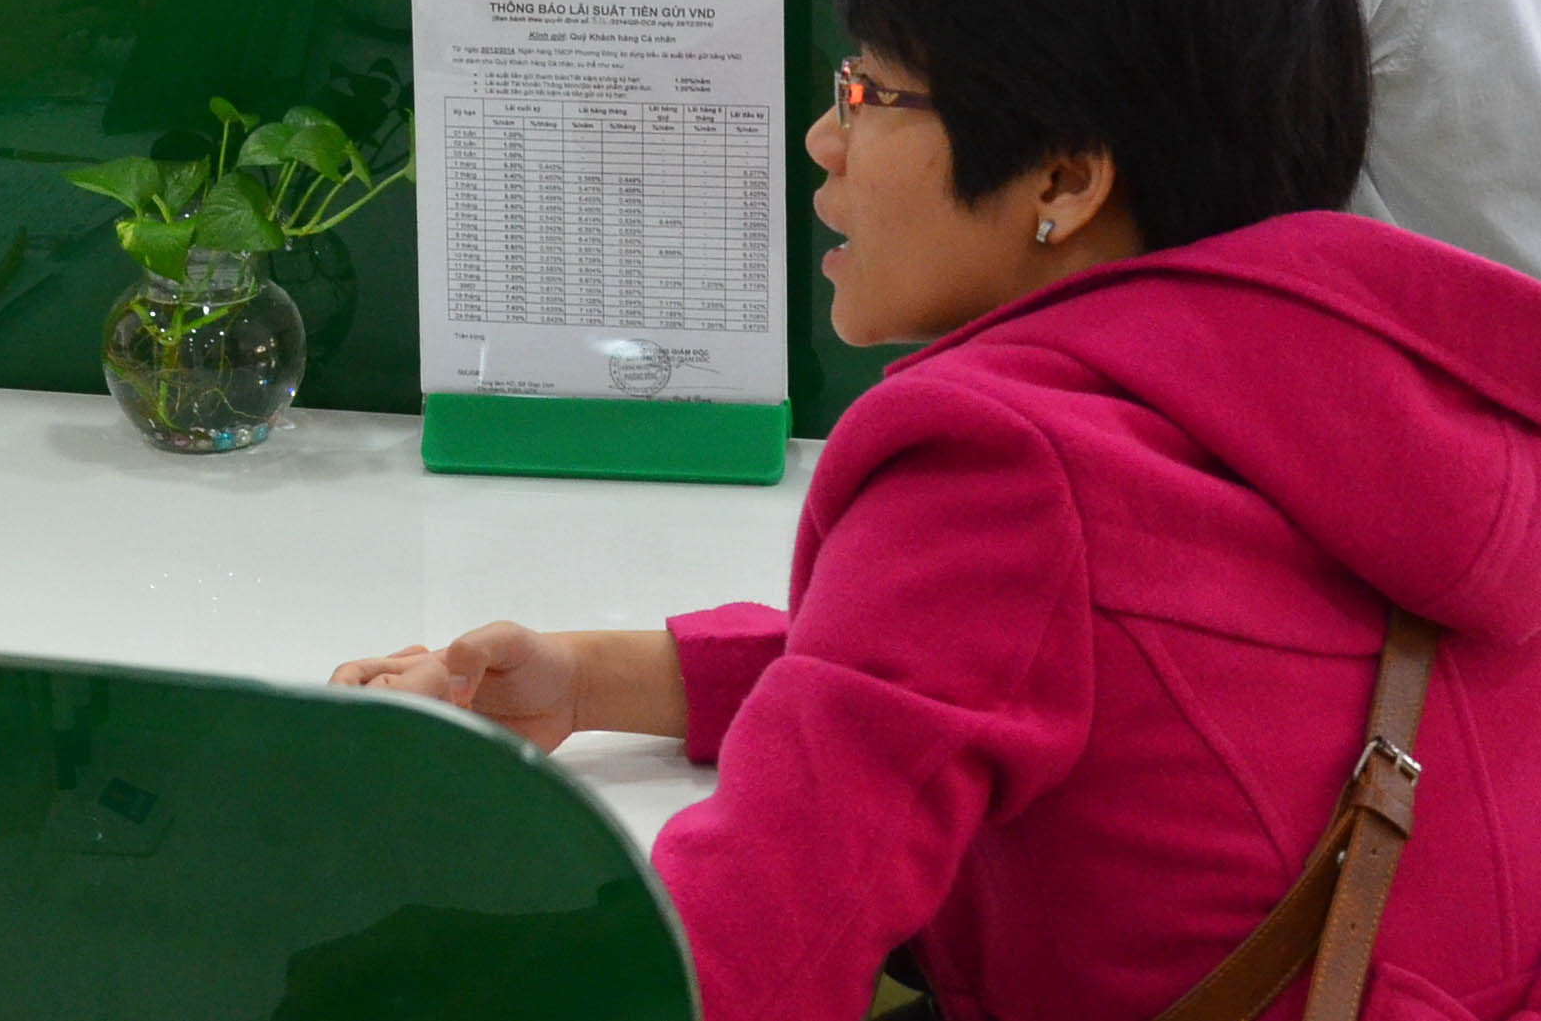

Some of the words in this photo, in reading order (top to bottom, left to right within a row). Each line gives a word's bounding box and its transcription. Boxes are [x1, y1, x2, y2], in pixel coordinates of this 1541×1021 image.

[489, 0, 534, 13] THÔNG
[538, 1, 566, 14] BÁO
[569, 2, 590, 14] LÃI
[592, 3, 627, 17] SUẤT
[630, 4, 658, 17] TIỀN
[661, 5, 686, 18] GỬI
[688, 8, 716, 18] VND
